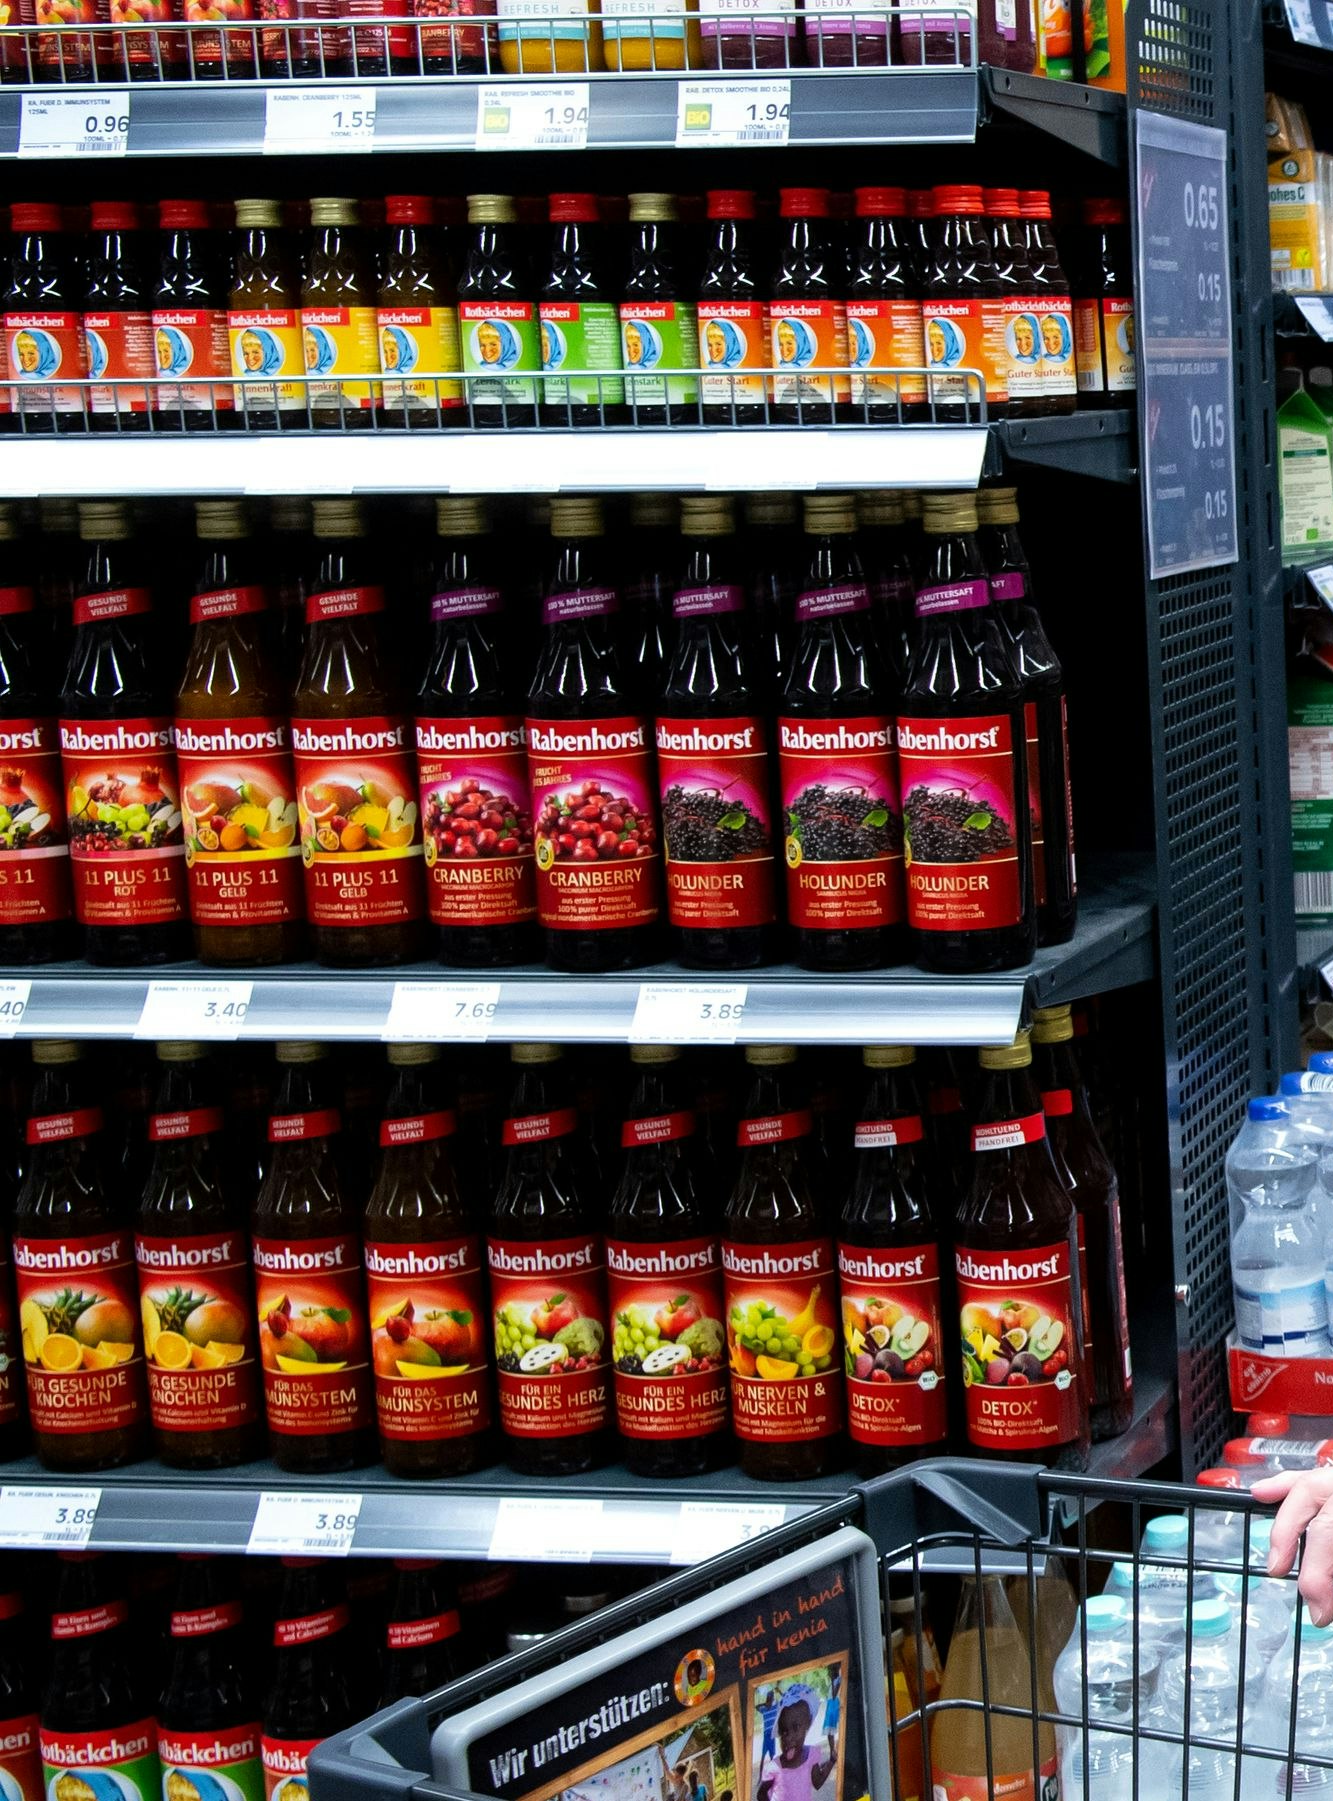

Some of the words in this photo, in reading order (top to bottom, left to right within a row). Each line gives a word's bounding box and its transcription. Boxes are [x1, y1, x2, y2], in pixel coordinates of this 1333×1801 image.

[718, 0, 760, 8] DETOX
[302, 94, 340, 102] CRANBERRY
[333, 111, 376, 129] 1.55
[544, 107, 590, 125] 1.94
[746, 103, 791, 121] 1.94
[85, 115, 130, 133] 0.96
[1184, 182, 1218, 230] 0.65
[1198, 272, 1222, 302] 0.15
[465, 306, 527, 319] Rotbäckchen
[1190, 403, 1225, 450] 0.15
[1205, 489, 1228, 520] 0.15
[566, 592, 616, 607] MUTTERSAFT
[682, 590, 729, 604] MUTTERSAFT
[817, 589, 867, 604] MUTTERSAFT
[927, 587, 974, 603] MUTTERSAFT
[90, 602, 128, 617] VIELFALT
[202, 602, 238, 617] VIELFALT
[321, 602, 359, 615] VIELFALT
[60, 726, 176, 751] Rabenhorst
[292, 726, 404, 751] Rabenhorst
[416, 725, 528, 750] Rabenhorst
[531, 727, 645, 752] Rabenhorst
[781, 725, 893, 750] Rabenhorst
[85, 871, 99, 886] 11
[104, 868, 147, 885] PLUS
[153, 867, 171, 883] 11
[212, 869, 253, 886] PLUS
[260, 868, 279, 884] 11
[333, 870, 374, 887] PLUS
[380, 868, 399, 884] 11
[433, 866, 524, 884] CRANBERRY
[549, 867, 643, 888] CRANBERRY
[799, 873, 887, 890] HOLUNDER
[114, 886, 137, 897] ROT
[219, 886, 248, 898] GELB
[339, 887, 368, 899] GELB
[844, 899, 878, 911] Pressung
[847, 907, 883, 918] Direktsaft
[946, 902, 980, 912] Pressung
[948, 909, 985, 920] Direktsaft
[204, 1002, 248, 1018] 3.40
[454, 1002, 497, 1018] 7.69
[700, 1003, 744, 1020] 3.89
[36, 1117, 74, 1131] GESUNDE
[156, 1116, 190, 1129] GESUNDE
[272, 1117, 304, 1130] GESUNDE
[38, 1125, 74, 1139] VIELFALT
[157, 1125, 190, 1138] VIELFALT
[607, 1244, 715, 1273] Rabenhorst
[48, 1371, 128, 1392] GESUNDE
[162, 1372, 237, 1391] GESUNDE
[274, 1380, 290, 1392] FÜR
[292, 1379, 314, 1392] DAS
[521, 1384, 540, 1396] FÜR
[543, 1384, 561, 1395] EIN
[35, 1389, 112, 1408] KNOCHEN
[152, 1389, 220, 1407] KNOCHEN
[393, 1385, 411, 1397] FÜR
[414, 1386, 437, 1398] DAS
[567, 1386, 605, 1407] HERZ
[616, 1394, 686, 1412] GESUNDES
[691, 1387, 727, 1410] HERZ
[643, 1385, 662, 1397] FÜR
[666, 1385, 685, 1396] EIN
[747, 1386, 809, 1401] NERVEN
[813, 1382, 826, 1397] &
[739, 1400, 807, 1416] MUSKELN
[56, 1507, 97, 1524] 3.89
[315, 1513, 358, 1530] 3.89
[716, 1618, 766, 1657] hand
[772, 1608, 792, 1629] in
[798, 1574, 845, 1613] hand
[739, 1651, 767, 1679] für
[777, 1619, 829, 1653] kenia
[489, 1746, 529, 1789] Wir
[533, 1681, 670, 1769] unterstützen:
